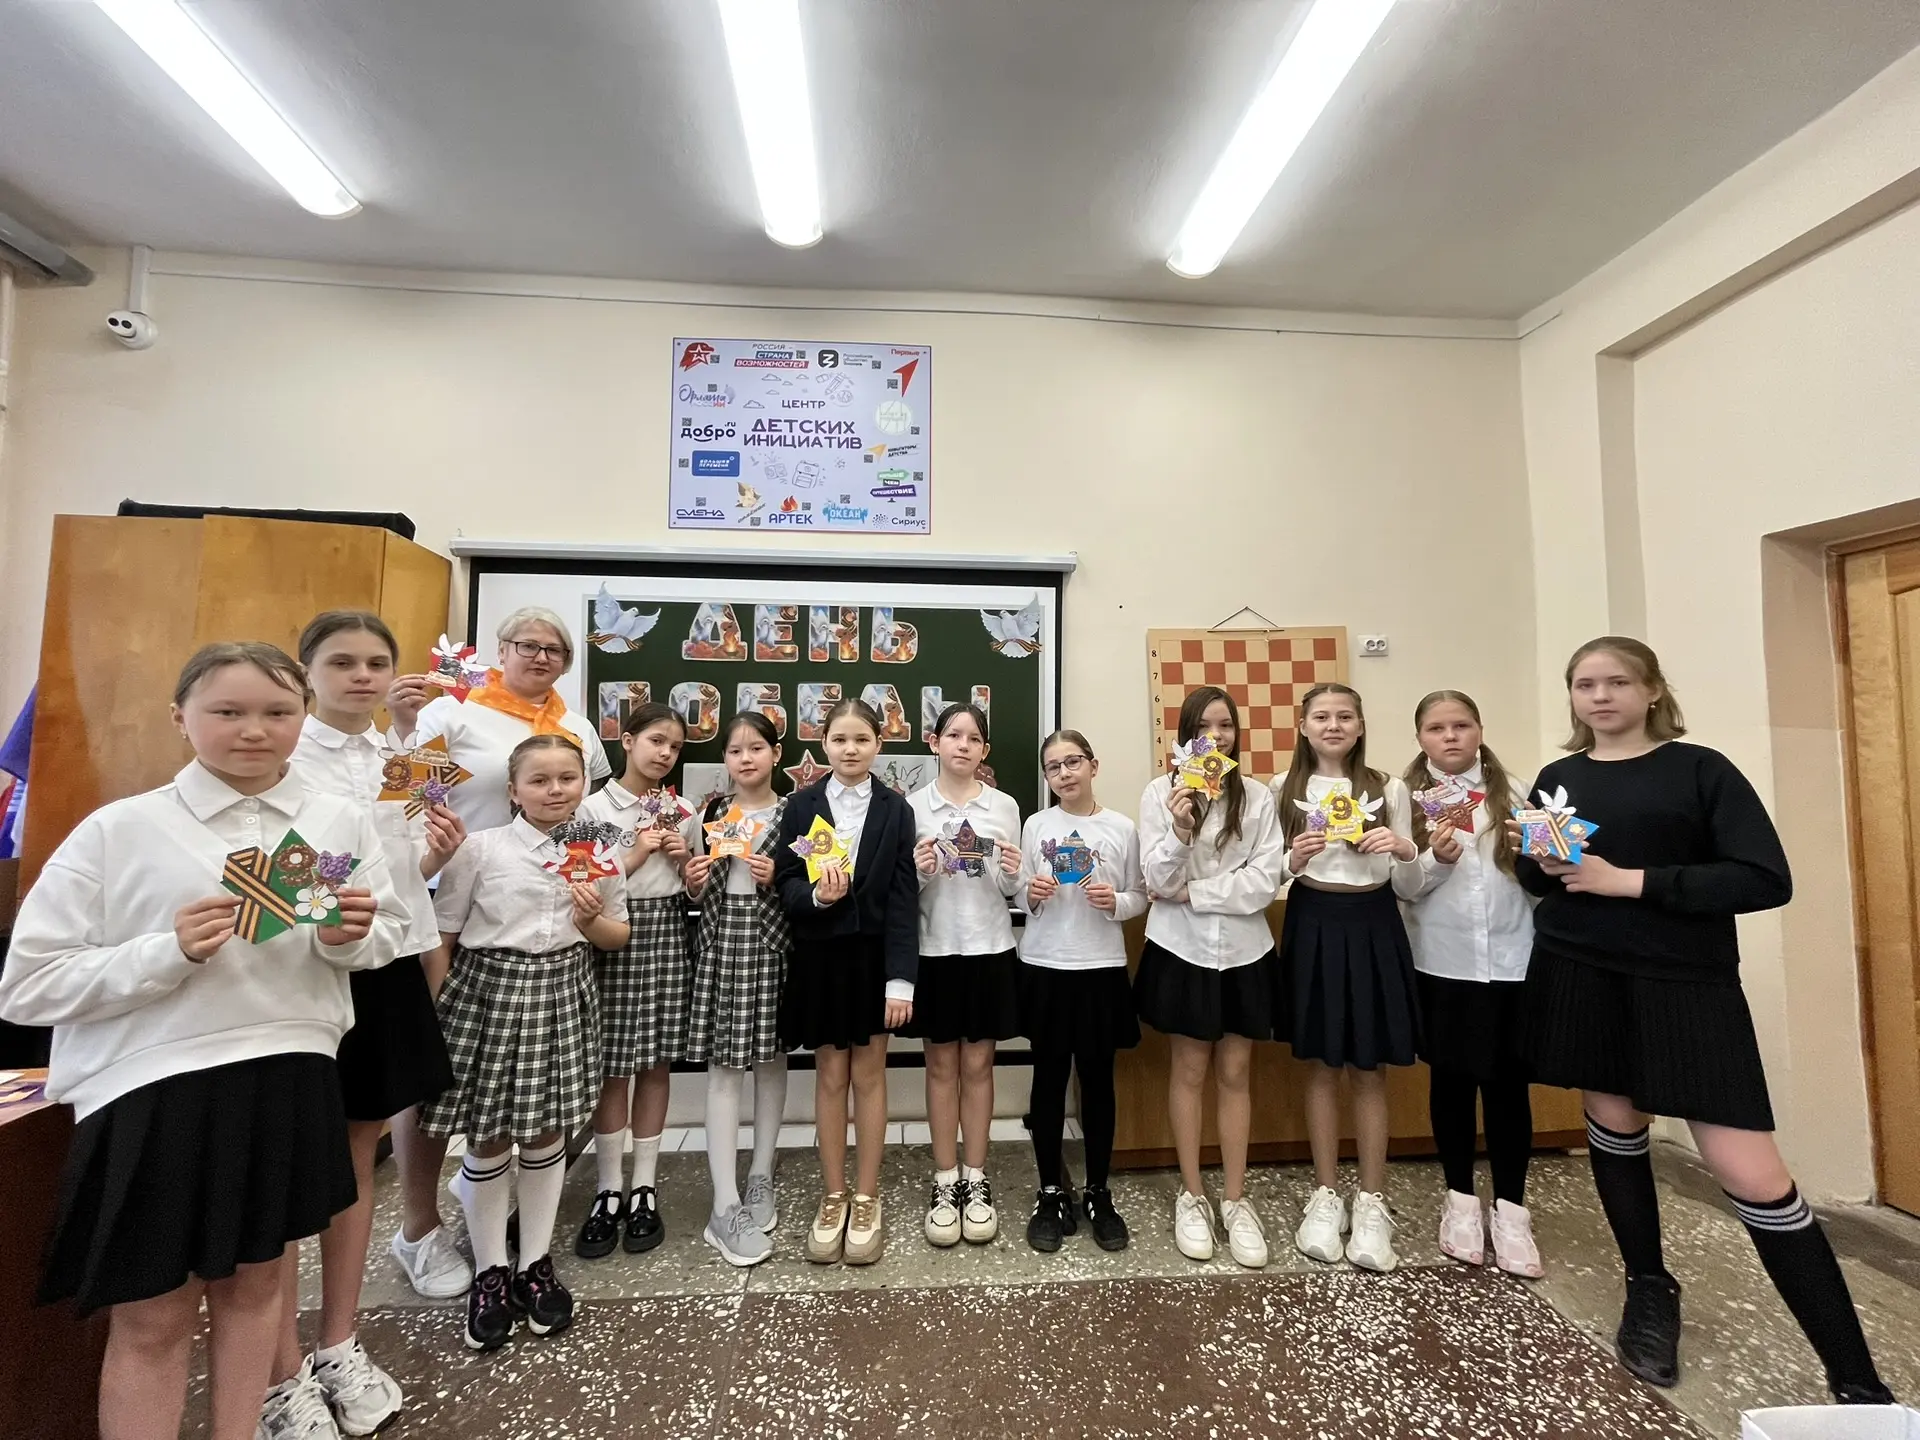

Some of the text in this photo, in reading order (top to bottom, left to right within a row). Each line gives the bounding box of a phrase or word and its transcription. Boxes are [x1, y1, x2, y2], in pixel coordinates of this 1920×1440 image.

[736, 360, 806, 368] ВОЗМОЖНОСТЕЙ
[781, 399, 826, 409] ЦЕНТР
[751, 418, 855, 434] ДЕТСКИХ
[681, 424, 736, 441] добро
[743, 433, 862, 450] ИНИЦИАТИВ
[768, 513, 813, 525] АРТЕК
[829, 509, 861, 519] ОКЕАН
[891, 517, 926, 527] Сириус
[681, 601, 919, 663] ДЕНЬ
[1151, 649, 1157, 658] 8
[1153, 672, 1158, 680] 7
[1154, 694, 1160, 703] 6
[1155, 717, 1161, 726] 5
[1156, 736, 1162, 744] 4
[1157, 759, 1163, 768] 3
[1203, 755, 1223, 780] 9
[802, 763, 814, 780] 9
[1330, 795, 1353, 820] 9
[811, 829, 833, 855] 9
